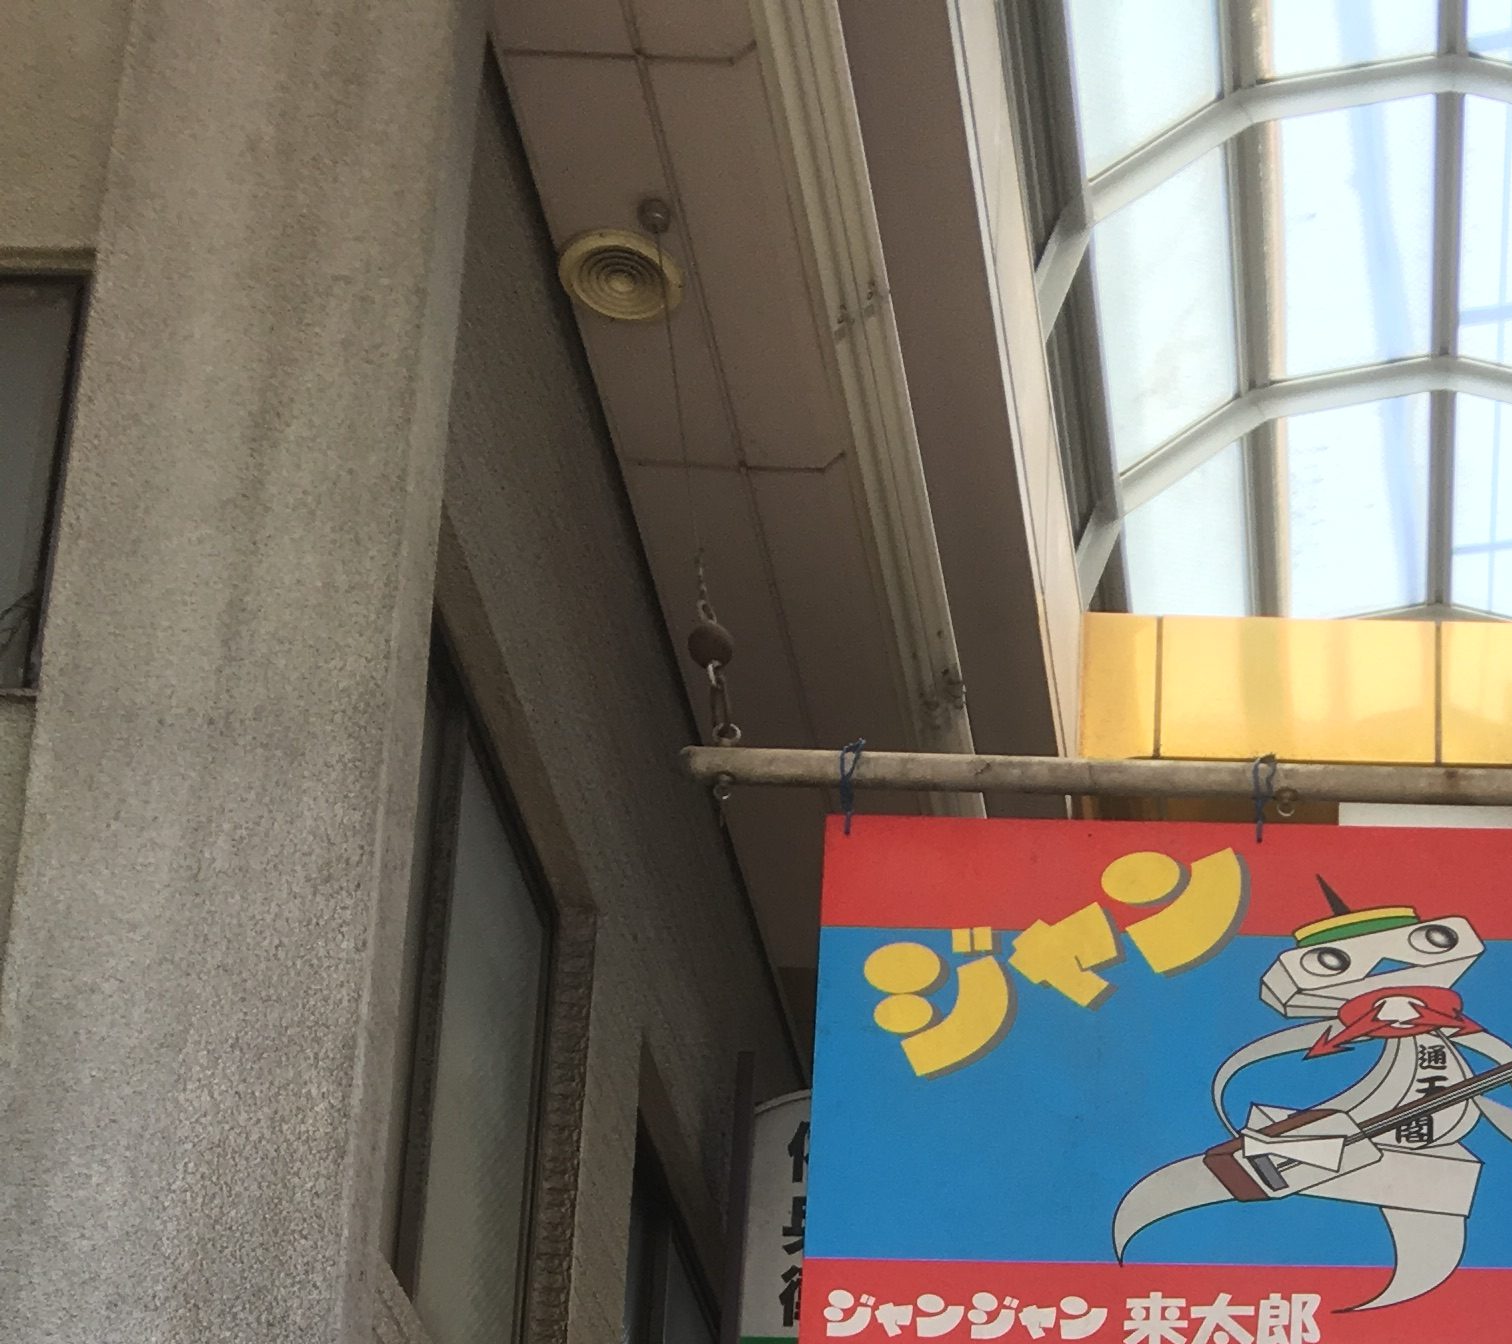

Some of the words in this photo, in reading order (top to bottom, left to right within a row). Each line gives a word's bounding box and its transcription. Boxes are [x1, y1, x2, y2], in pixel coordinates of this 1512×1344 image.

[862, 846, 1245, 1076] ジャン
[822, 1289, 1107, 1339] ジャンジャン
